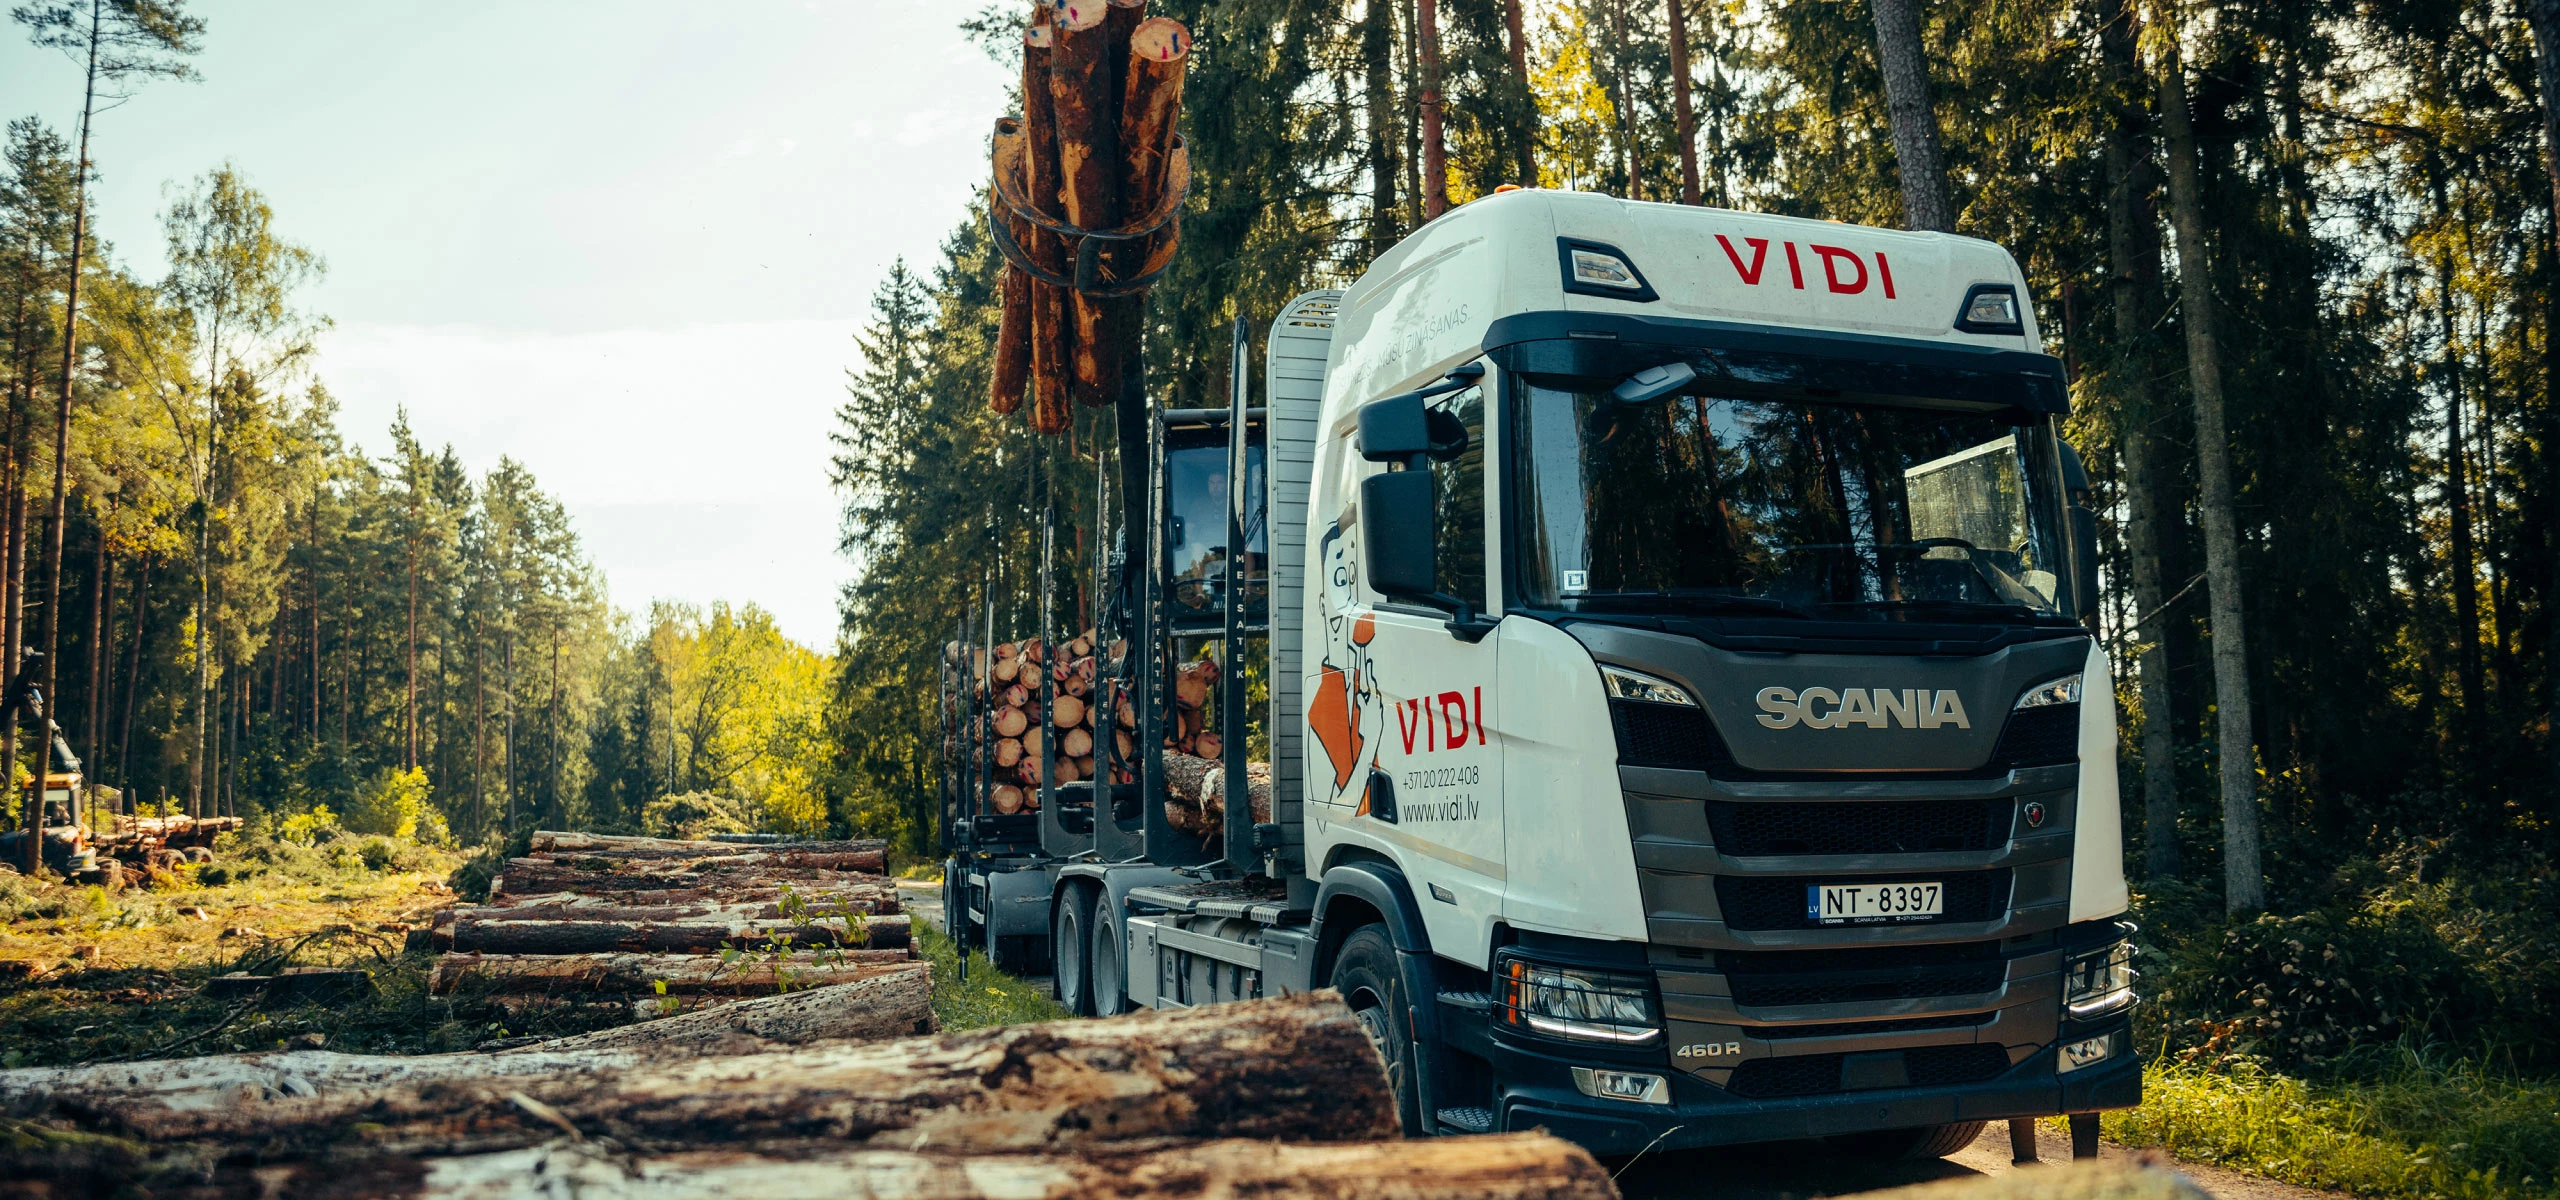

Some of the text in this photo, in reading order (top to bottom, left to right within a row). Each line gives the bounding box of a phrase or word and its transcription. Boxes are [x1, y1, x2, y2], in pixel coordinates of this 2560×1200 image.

[1713, 233, 1897, 300] VIDI
[1235, 554, 1245, 679] METSATEK
[1153, 600, 1162, 705] METSATEK
[1395, 686, 1486, 756] VIDI
[1755, 686, 1971, 730] SCANIA
[1402, 765, 1480, 790] +371 20 222 408
[1403, 793, 1480, 823] www.vidi.lv
[1808, 905, 1819, 914] LV
[1826, 885, 1939, 915] NT-8397
[1676, 1041, 1741, 1058] 460 R
